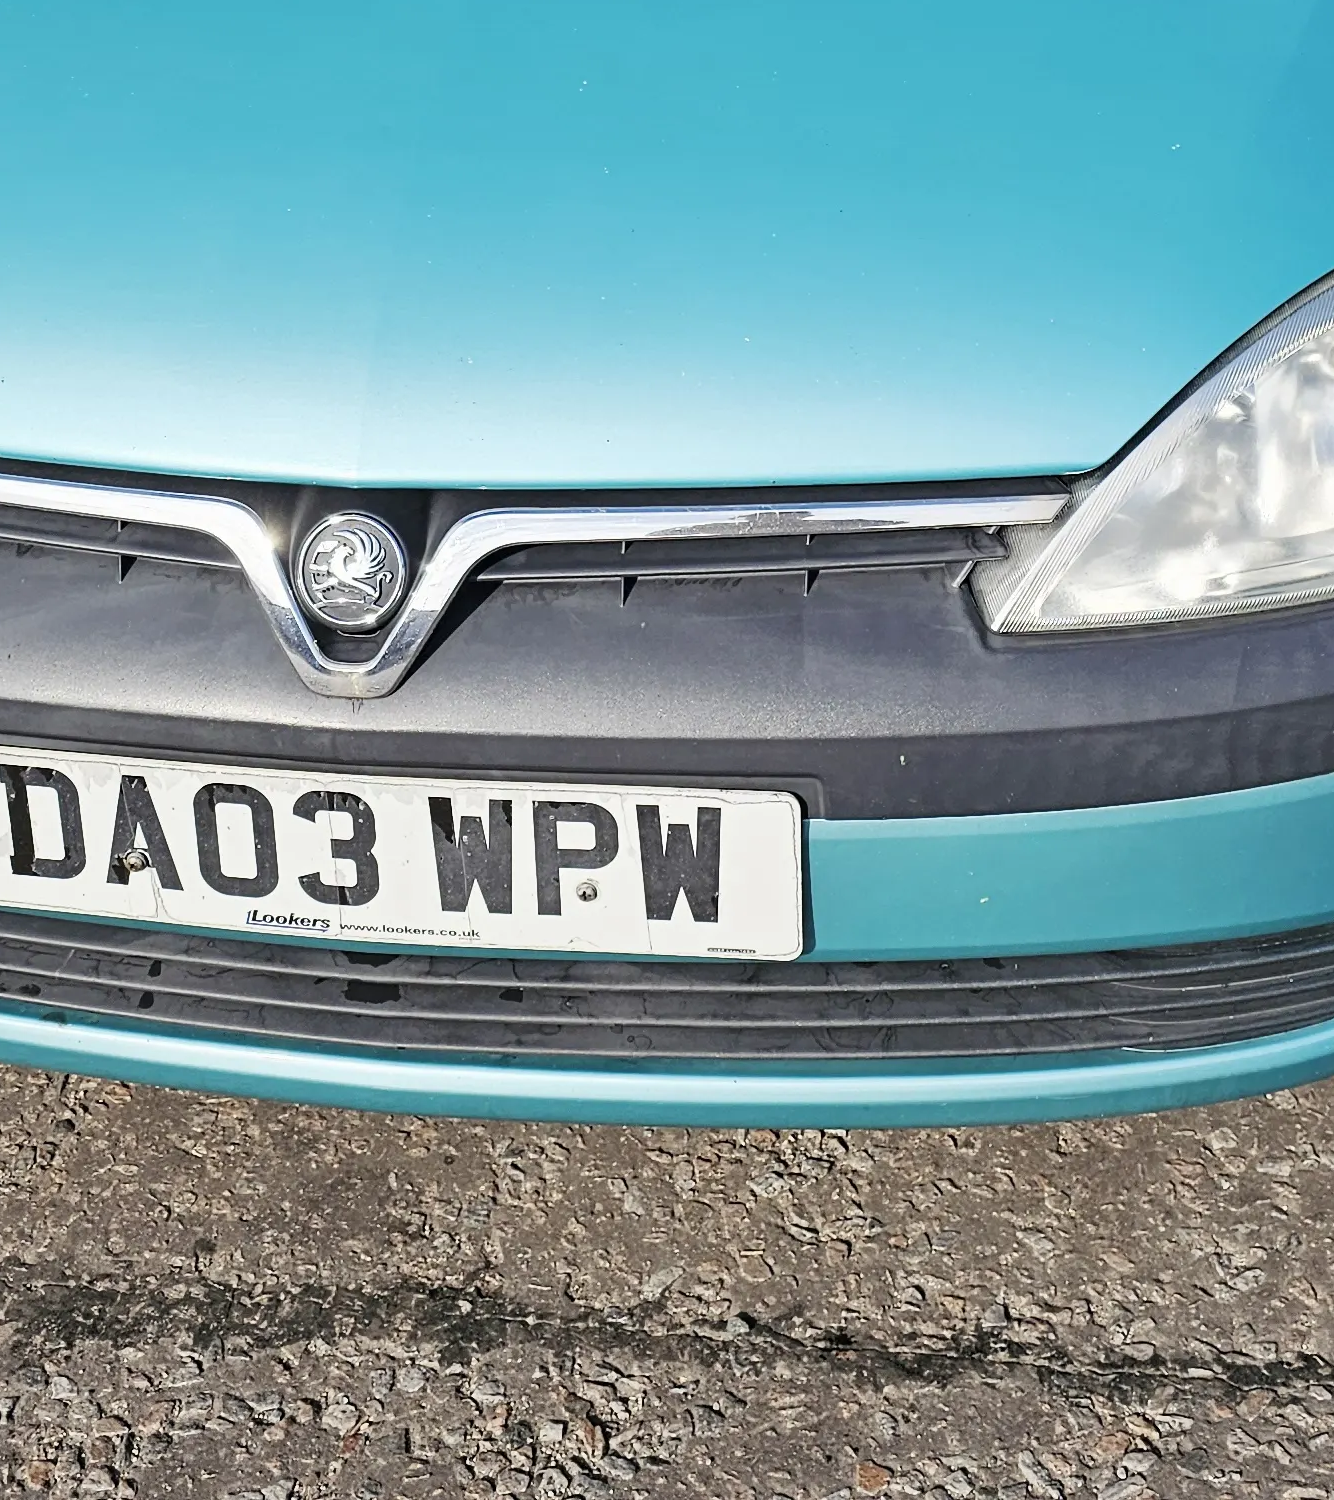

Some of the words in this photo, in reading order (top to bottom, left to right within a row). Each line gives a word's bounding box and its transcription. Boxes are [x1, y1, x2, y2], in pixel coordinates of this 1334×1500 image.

[427, 796, 721, 923] WPW
[251, 909, 331, 929] Lookers
[340, 923, 481, 938] www.lookers.co.uk
